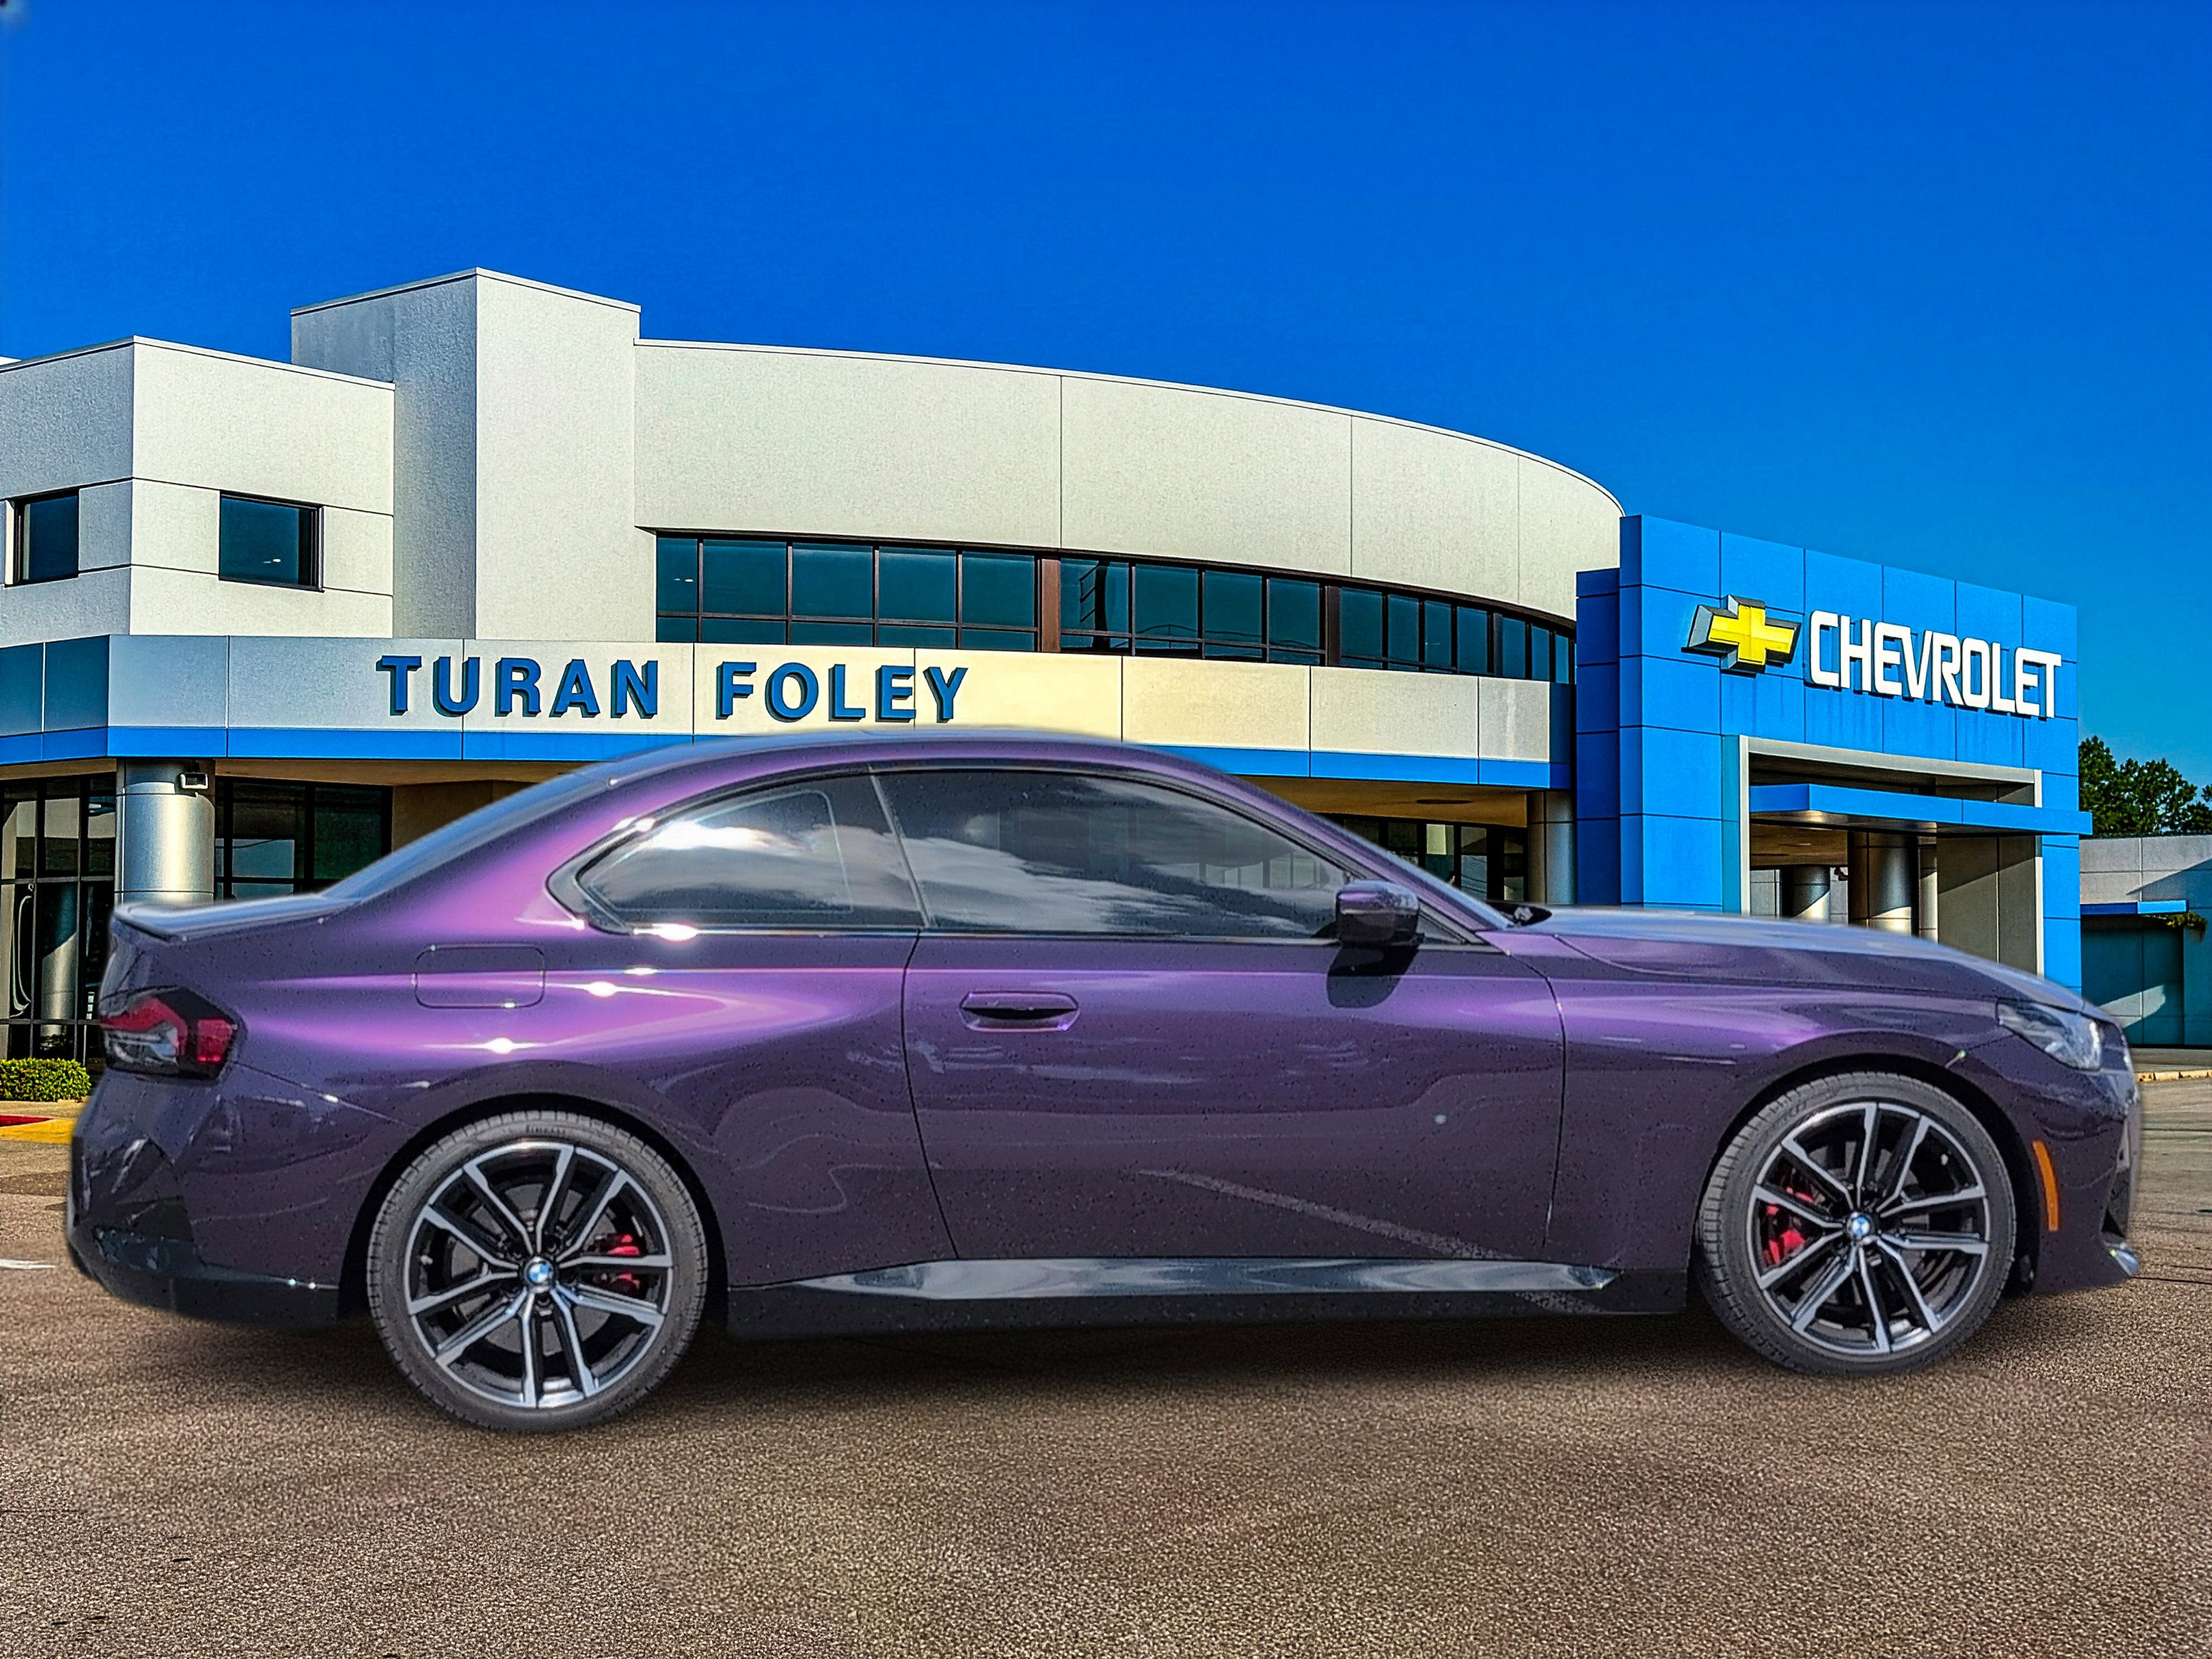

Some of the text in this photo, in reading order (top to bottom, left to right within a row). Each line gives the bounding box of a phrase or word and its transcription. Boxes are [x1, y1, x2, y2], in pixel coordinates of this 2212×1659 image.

[376, 655, 968, 723] TURAN FOLEY
[1809, 610, 2062, 718] CHEVROLET
